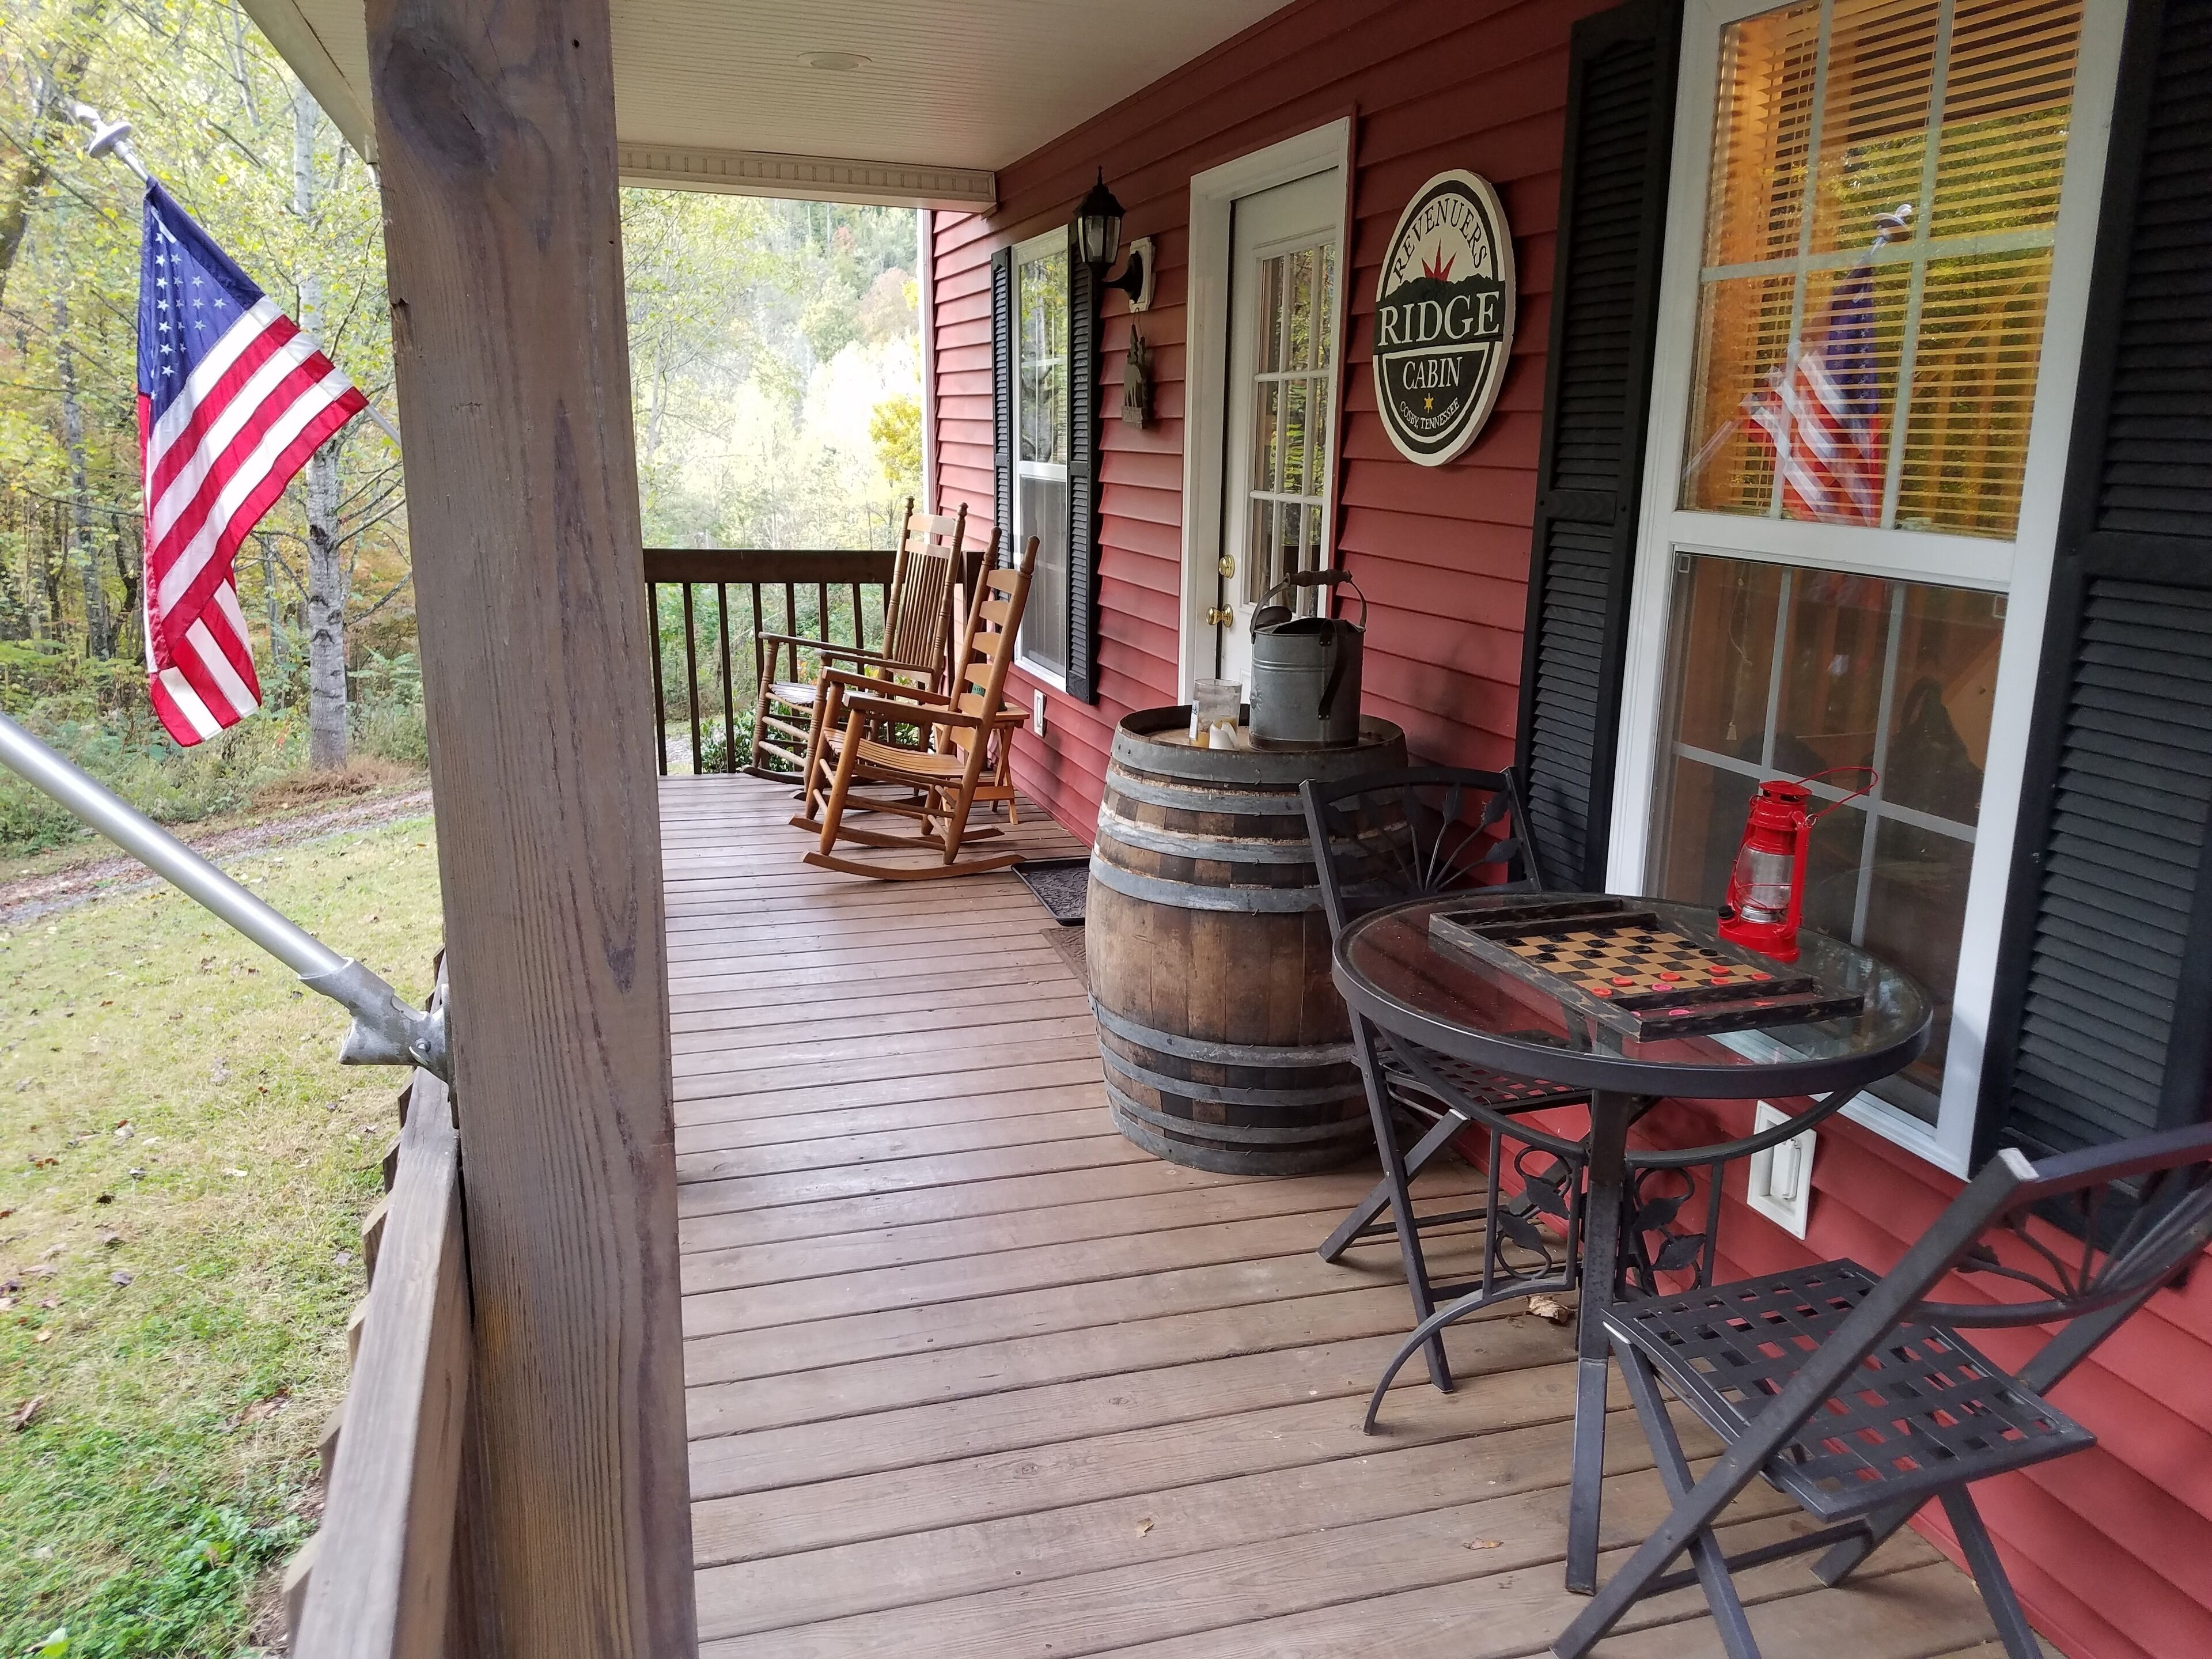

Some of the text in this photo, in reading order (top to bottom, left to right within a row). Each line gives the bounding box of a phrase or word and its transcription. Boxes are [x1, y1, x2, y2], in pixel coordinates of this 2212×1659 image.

[1393, 198, 1488, 283] REVENUERS
[1377, 291, 1499, 346] RIDGE
[1403, 356, 1463, 391] CABIN
[1400, 397, 1460, 430] COSBY, TENNESSEE
